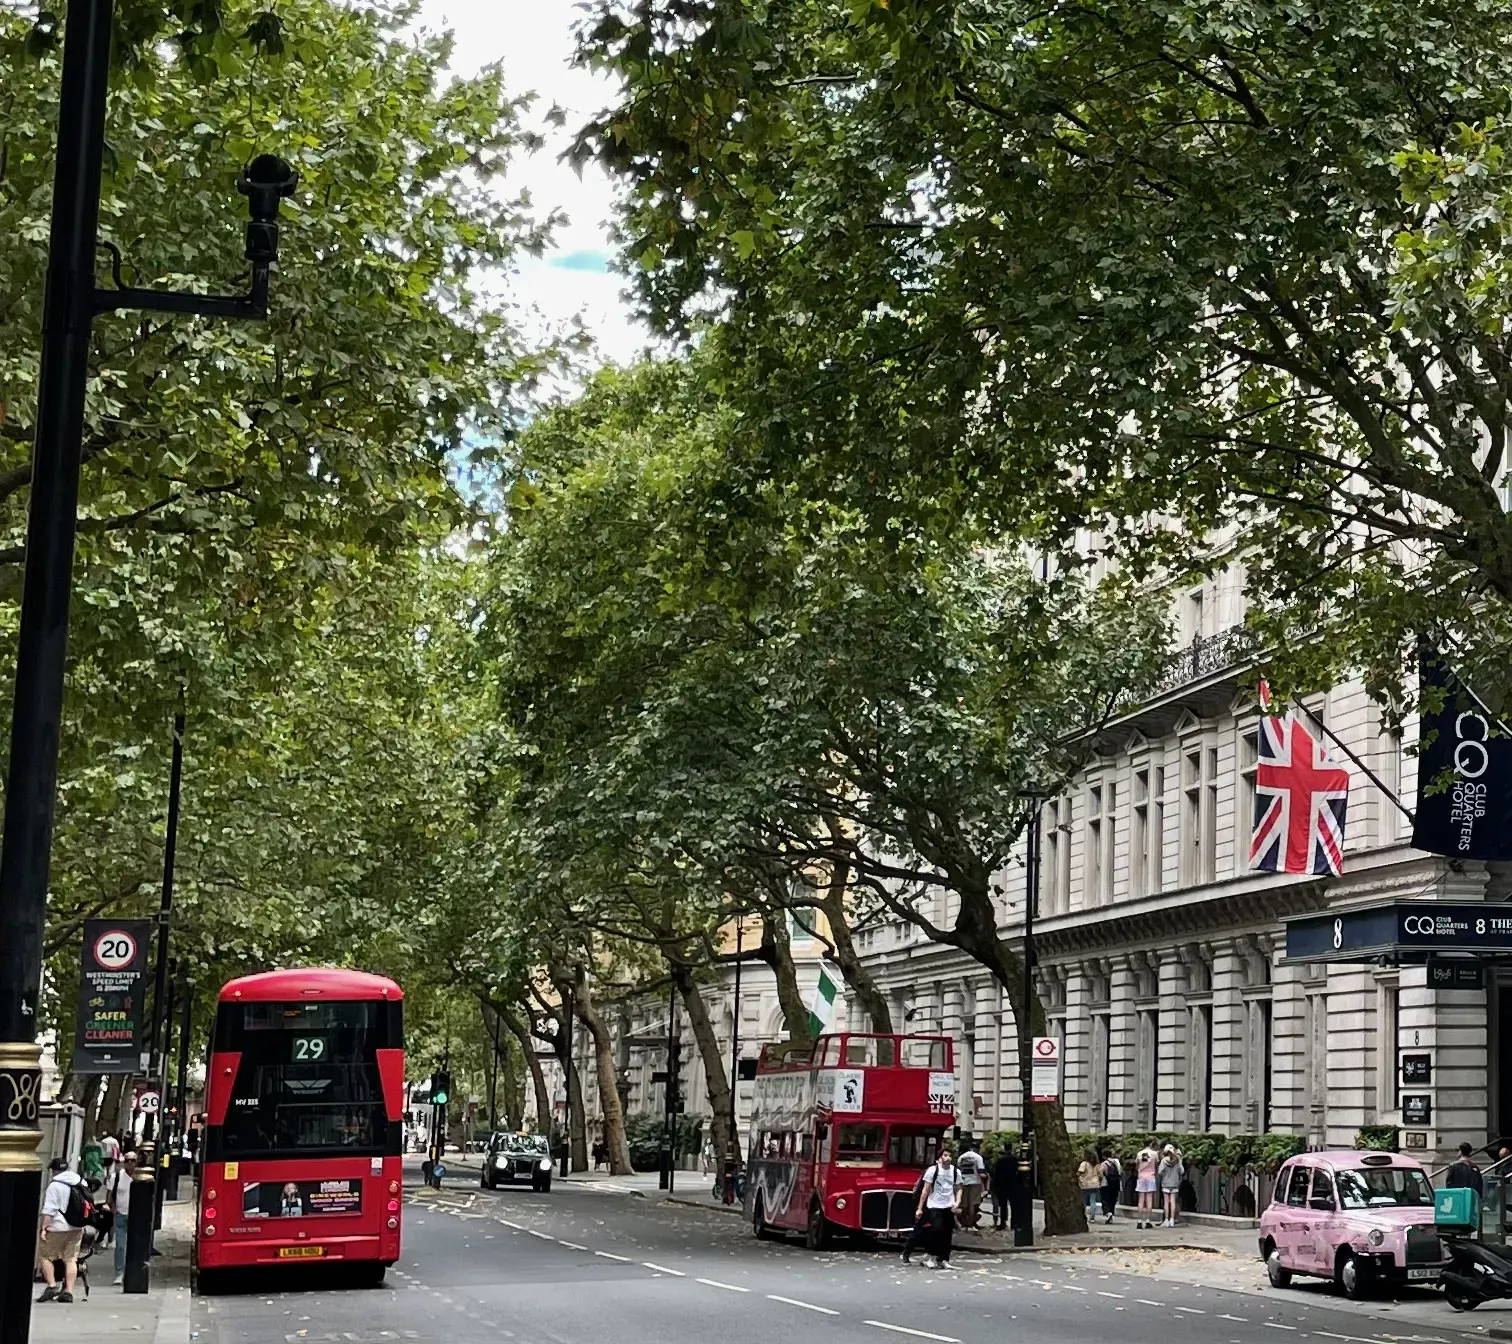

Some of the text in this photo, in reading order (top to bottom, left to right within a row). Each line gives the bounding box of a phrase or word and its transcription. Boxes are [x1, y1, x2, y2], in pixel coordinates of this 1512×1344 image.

[1453, 710, 1490, 778] CQ
[1450, 781, 1464, 823] HOTEL
[1475, 784, 1487, 818] CLUB
[1458, 782, 1477, 851] QUARTERS
[1333, 918, 1342, 948] 8
[1404, 916, 1435, 935] CQ
[1436, 922, 1468, 930] QUARTERS
[1475, 918, 1486, 934] 8
[101, 940, 129, 958] 20
[95, 1011, 127, 1021] SAFER
[85, 1021, 134, 1030] GREENER
[85, 1030, 133, 1040] CLEANER
[296, 1039, 324, 1059] 29
[142, 1097, 158, 1107] 20
